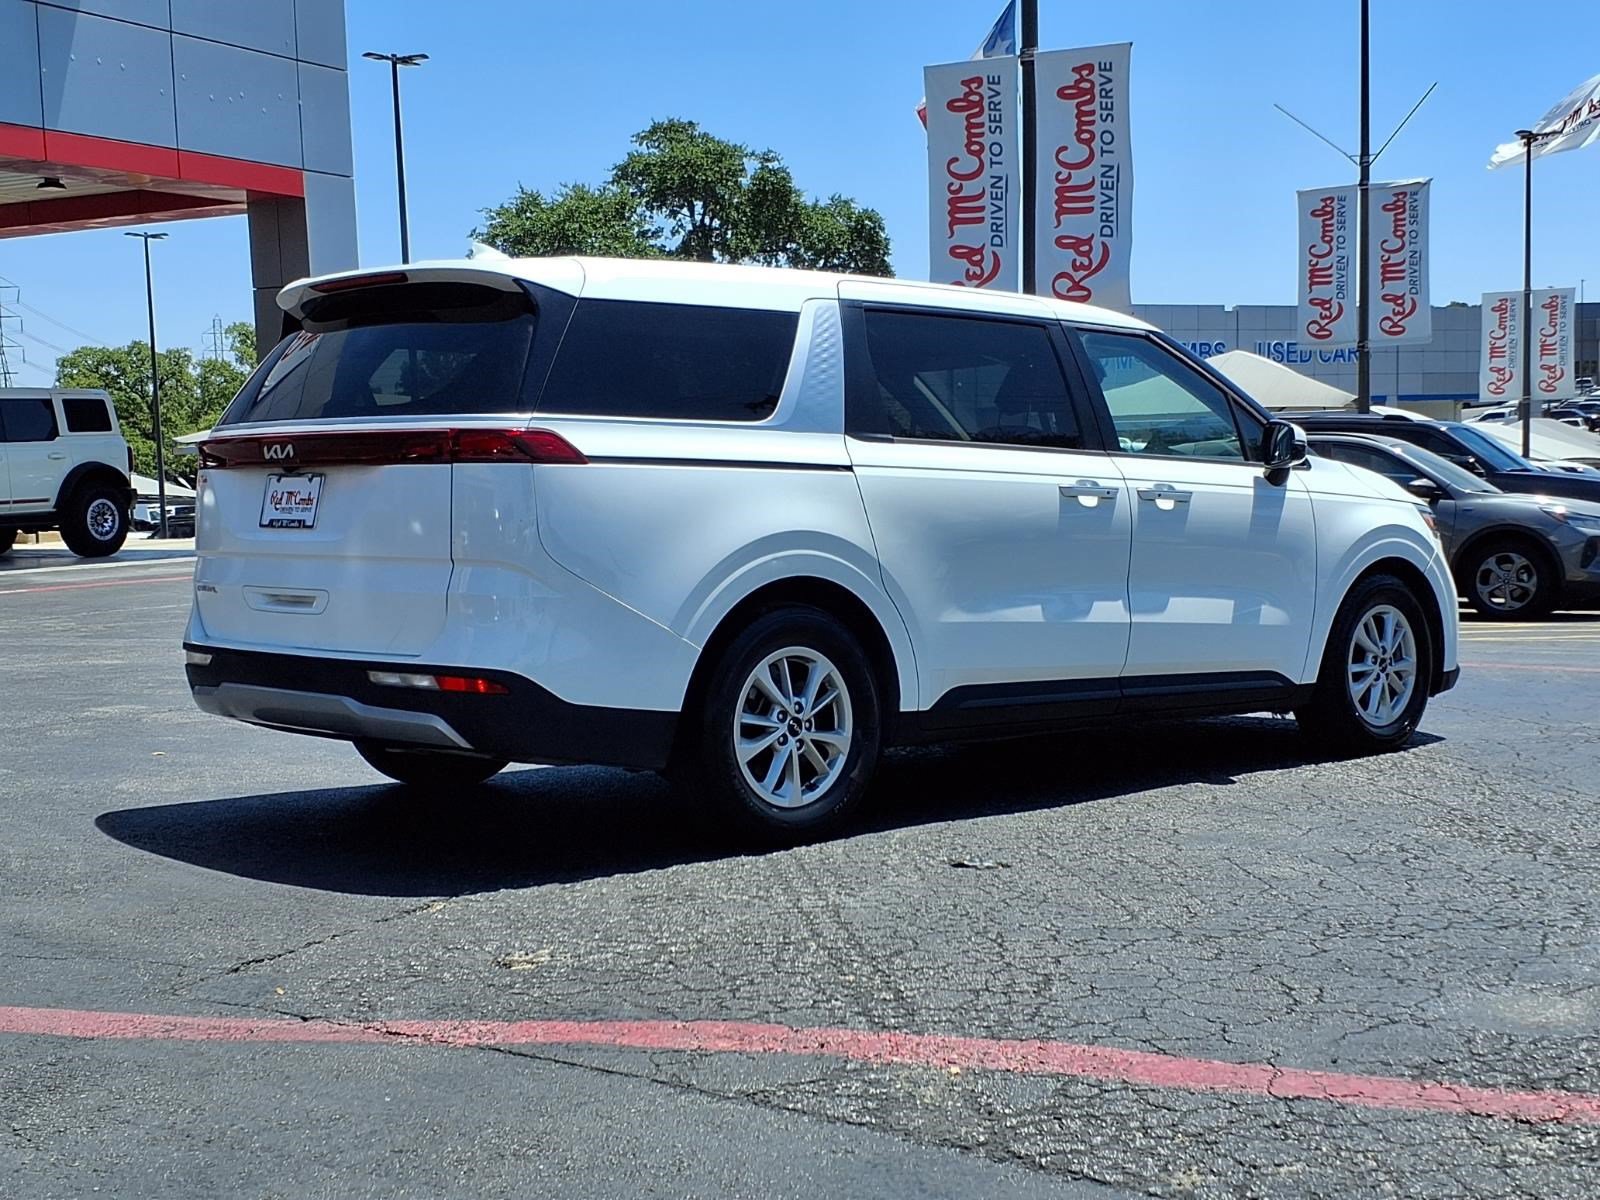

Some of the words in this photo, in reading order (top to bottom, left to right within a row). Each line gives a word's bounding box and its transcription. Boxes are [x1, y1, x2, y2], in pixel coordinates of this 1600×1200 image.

[987, 74, 1002, 135] SERVE
[1099, 61, 1113, 123] SERVE
[946, 75, 986, 239] McCombs
[989, 142, 1003, 168] TO
[1054, 62, 1095, 229] McCombs
[1100, 133, 1114, 158] TO
[989, 175, 1004, 248] DRIVEN
[1100, 165, 1114, 238] DRIVEN
[1336, 195, 1347, 231] SERVE
[1409, 191, 1419, 226] SERVE
[1308, 196, 1335, 293] McCombs
[1336, 236, 1346, 252] TO
[1380, 191, 1408, 290] McCombs
[1409, 232, 1418, 247] TO
[1052, 233, 1110, 303] Red
[1336, 255, 1346, 300] DRIVEN
[1409, 250, 1419, 295] DRIVEN
[1306, 297, 1343, 340] Red
[1379, 293, 1417, 336] Red
[1489, 297, 1509, 364] McCombs
[1539, 294, 1559, 362] McCombs
[1258, 342, 1312, 363] USED
[1487, 366, 1514, 395] Red
[1538, 364, 1564, 393] Red
